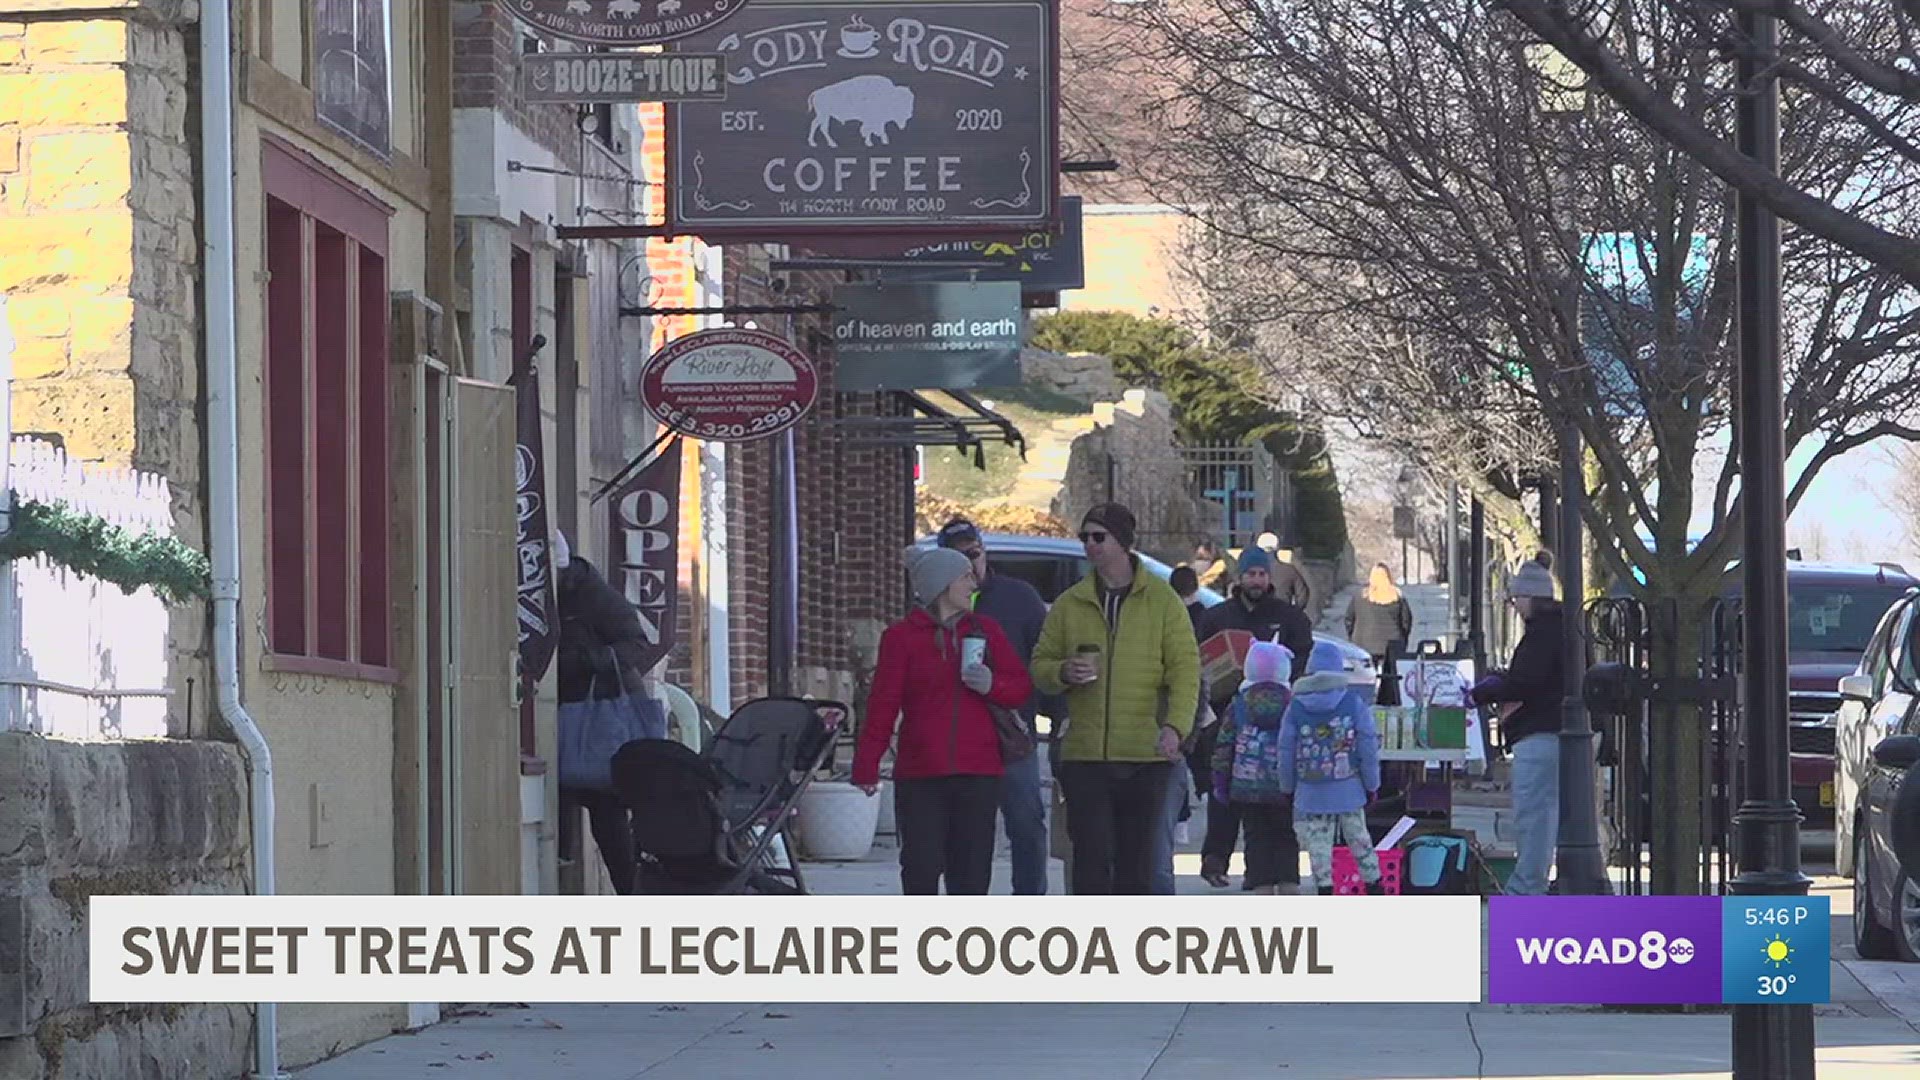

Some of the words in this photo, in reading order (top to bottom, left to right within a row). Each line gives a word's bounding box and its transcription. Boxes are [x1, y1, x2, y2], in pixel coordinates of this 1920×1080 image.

[578, 22, 624, 38] NORTH
[628, 21, 662, 38] CODY
[665, 13, 702, 33] ROAD
[554, 58, 717, 94] BOOZE-TIQUE
[721, 111, 765, 131] EST.
[956, 109, 1002, 131] 2020
[762, 157, 962, 193] COFFEE
[804, 198, 853, 213] NORTH
[861, 198, 898, 212] CODY
[906, 197, 946, 212] ROAD
[836, 320, 854, 338] of
[859, 320, 925, 338] heaven
[931, 319, 965, 336] and
[970, 318, 1016, 336] earth
[681, 354, 729, 376] River
